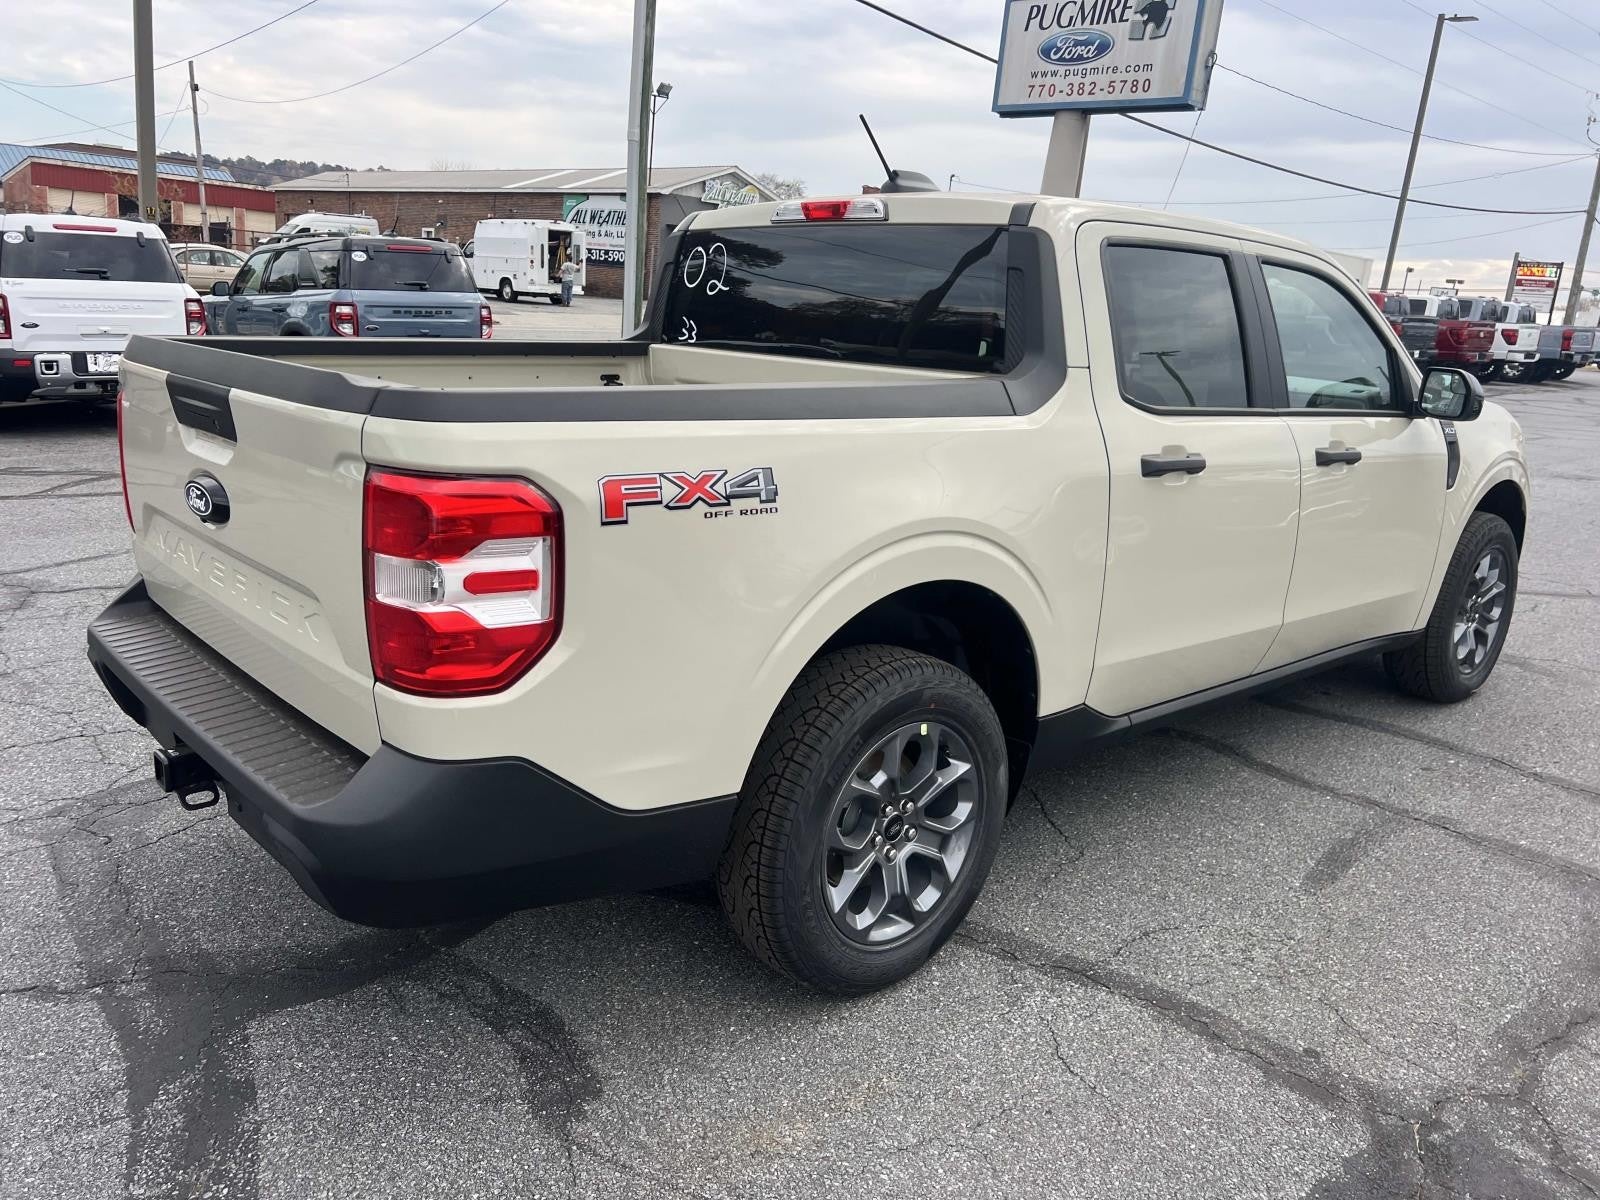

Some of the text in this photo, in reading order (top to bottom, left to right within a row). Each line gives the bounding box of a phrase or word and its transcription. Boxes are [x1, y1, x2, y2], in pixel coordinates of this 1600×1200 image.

[1024, 0, 1133, 32] PUGMIRE
[1049, 34, 1101, 60] Ford
[1030, 63, 1154, 80] www.pugmire.com
[1027, 78, 1152, 98] 770-382-5780
[570, 209, 626, 227] ALL WEATHE
[597, 230, 602, 238] &
[603, 230, 615, 239] Air,
[683, 242, 730, 296] 02
[189, 486, 206, 511] Ford
[598, 467, 778, 526] FX4
[703, 506, 779, 520] OFF ROAD
